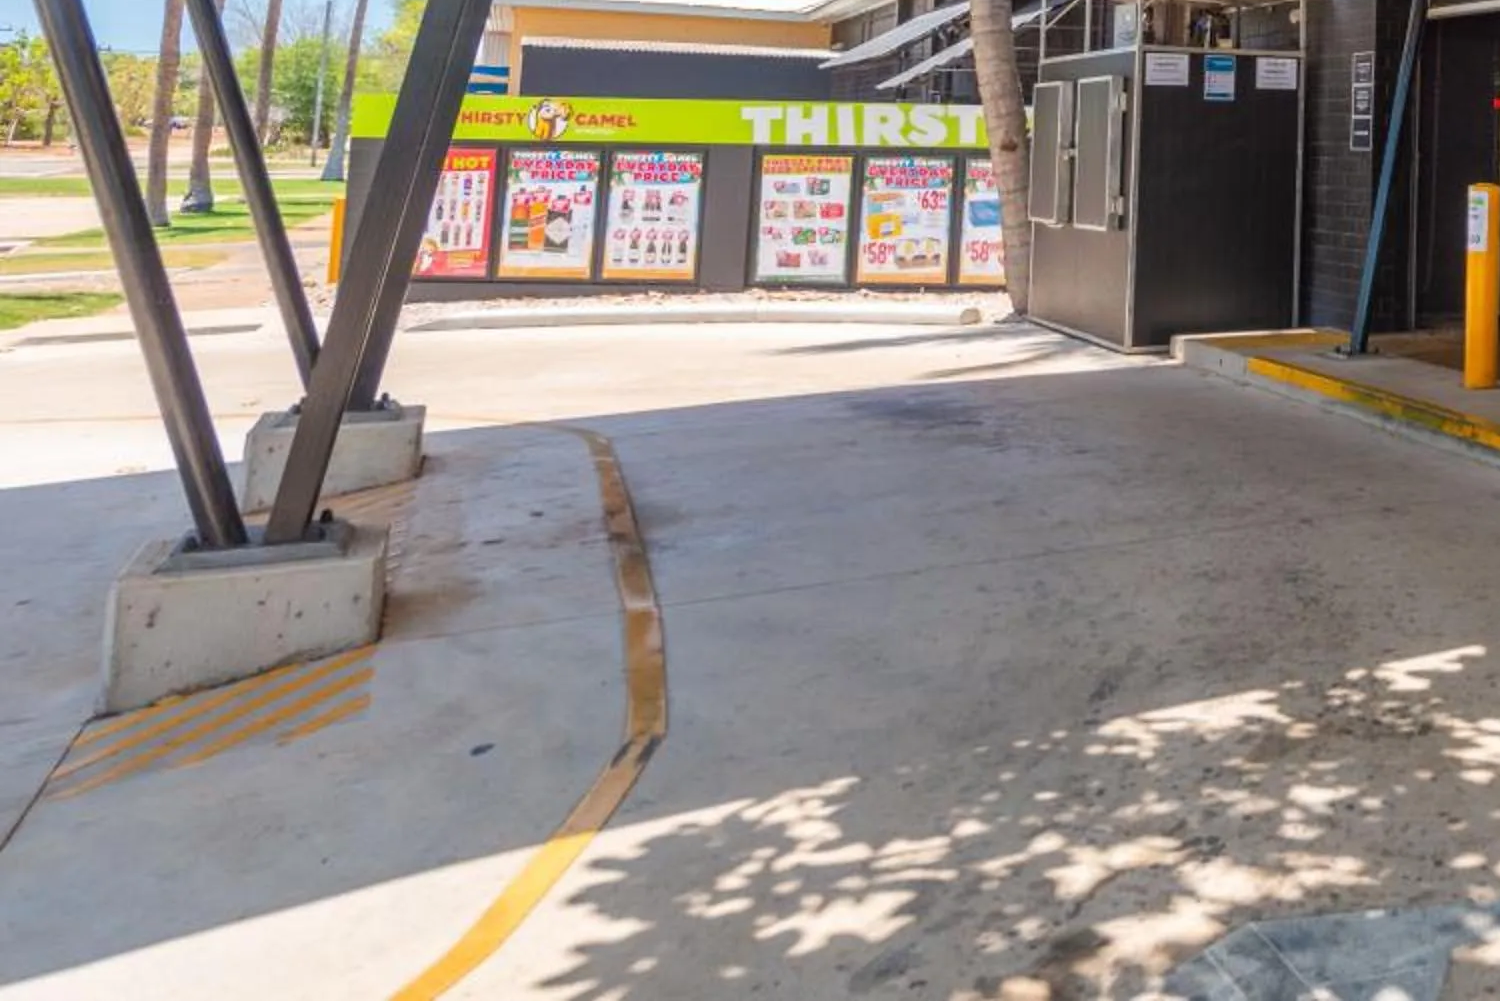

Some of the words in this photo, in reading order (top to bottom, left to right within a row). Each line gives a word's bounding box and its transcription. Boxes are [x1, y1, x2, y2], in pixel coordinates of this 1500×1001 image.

[459, 111, 526, 127] HIRSTY
[575, 113, 637, 127] CAMEL
[740, 103, 1034, 146] THIRST
[452, 156, 489, 170] HOT
